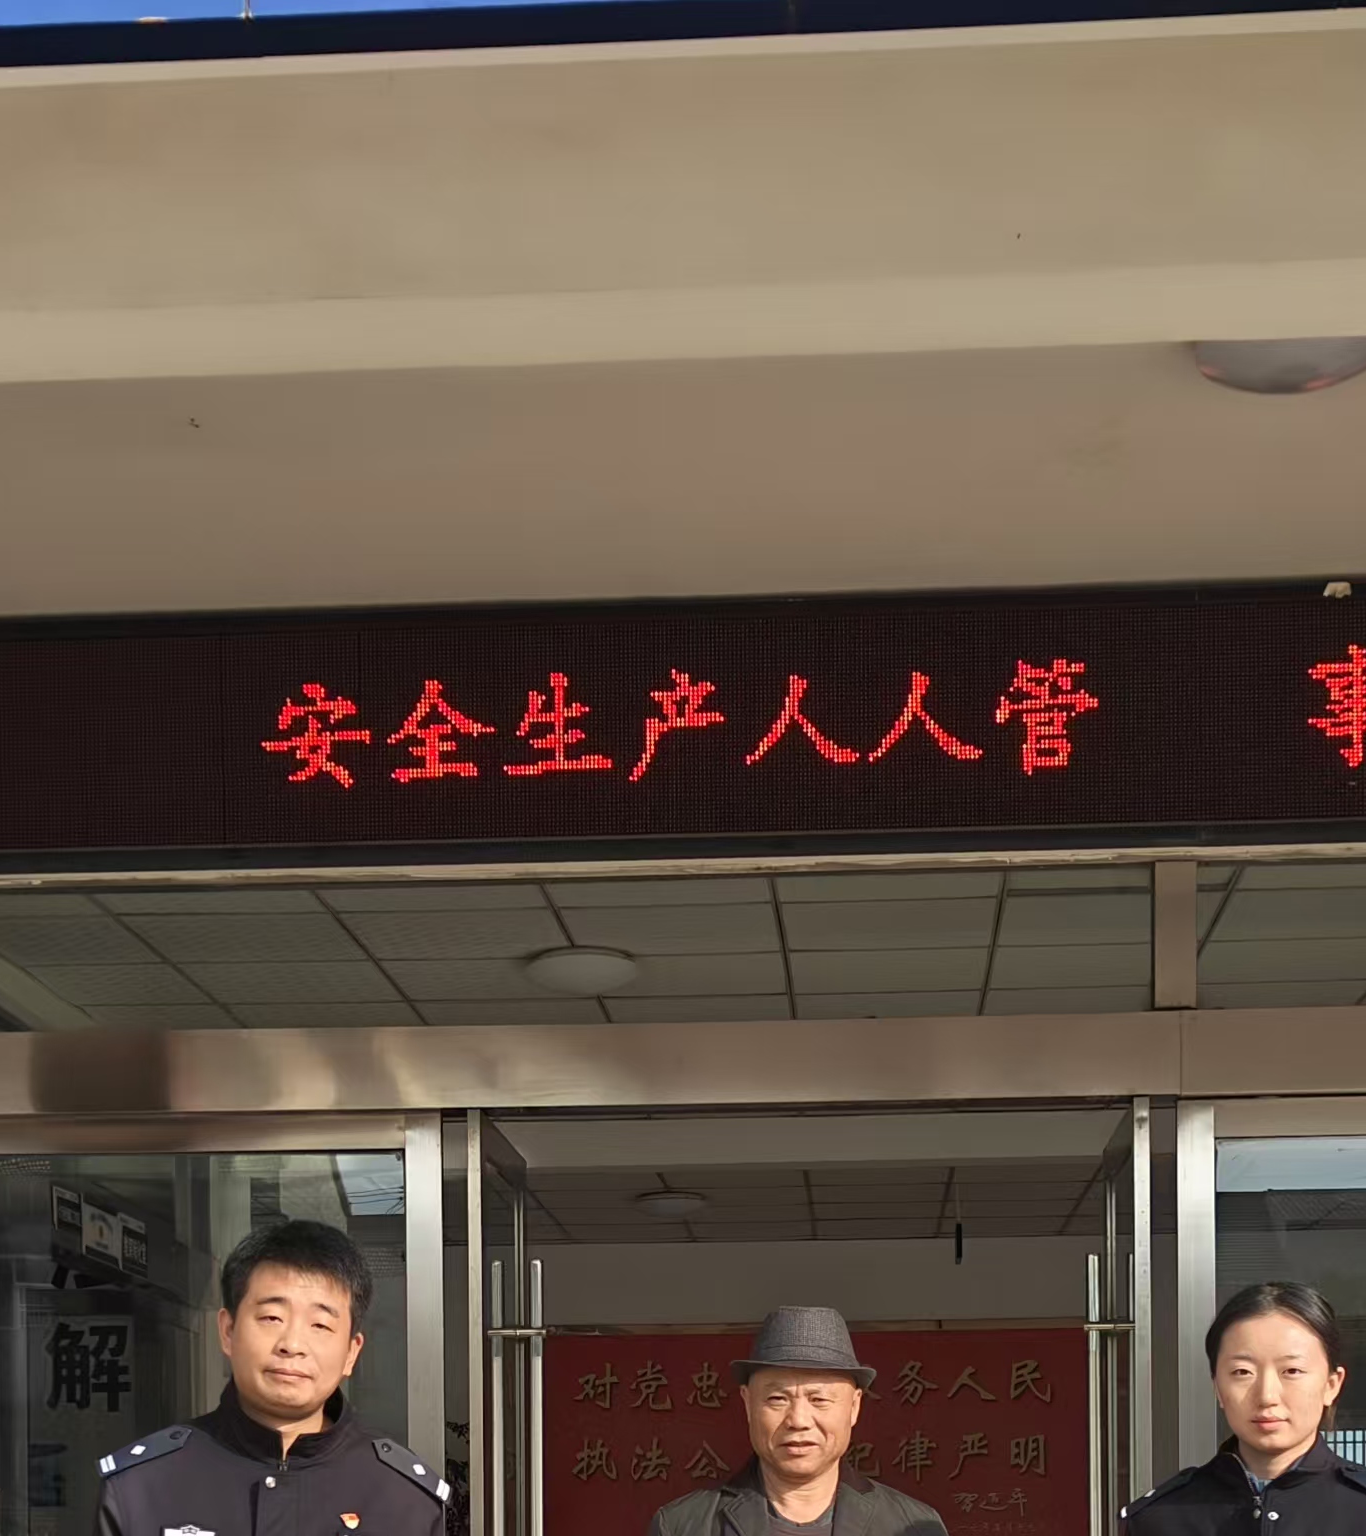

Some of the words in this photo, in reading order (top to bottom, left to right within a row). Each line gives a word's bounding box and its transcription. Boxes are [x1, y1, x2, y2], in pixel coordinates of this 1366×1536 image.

[261, 659, 1099, 789] 安全生产人人管
[45, 1322, 132, 1413] 解
[575, 1362, 730, 1410] 对党忠
[866, 1359, 1052, 1404] 务人民
[572, 1438, 731, 1482] 执法公
